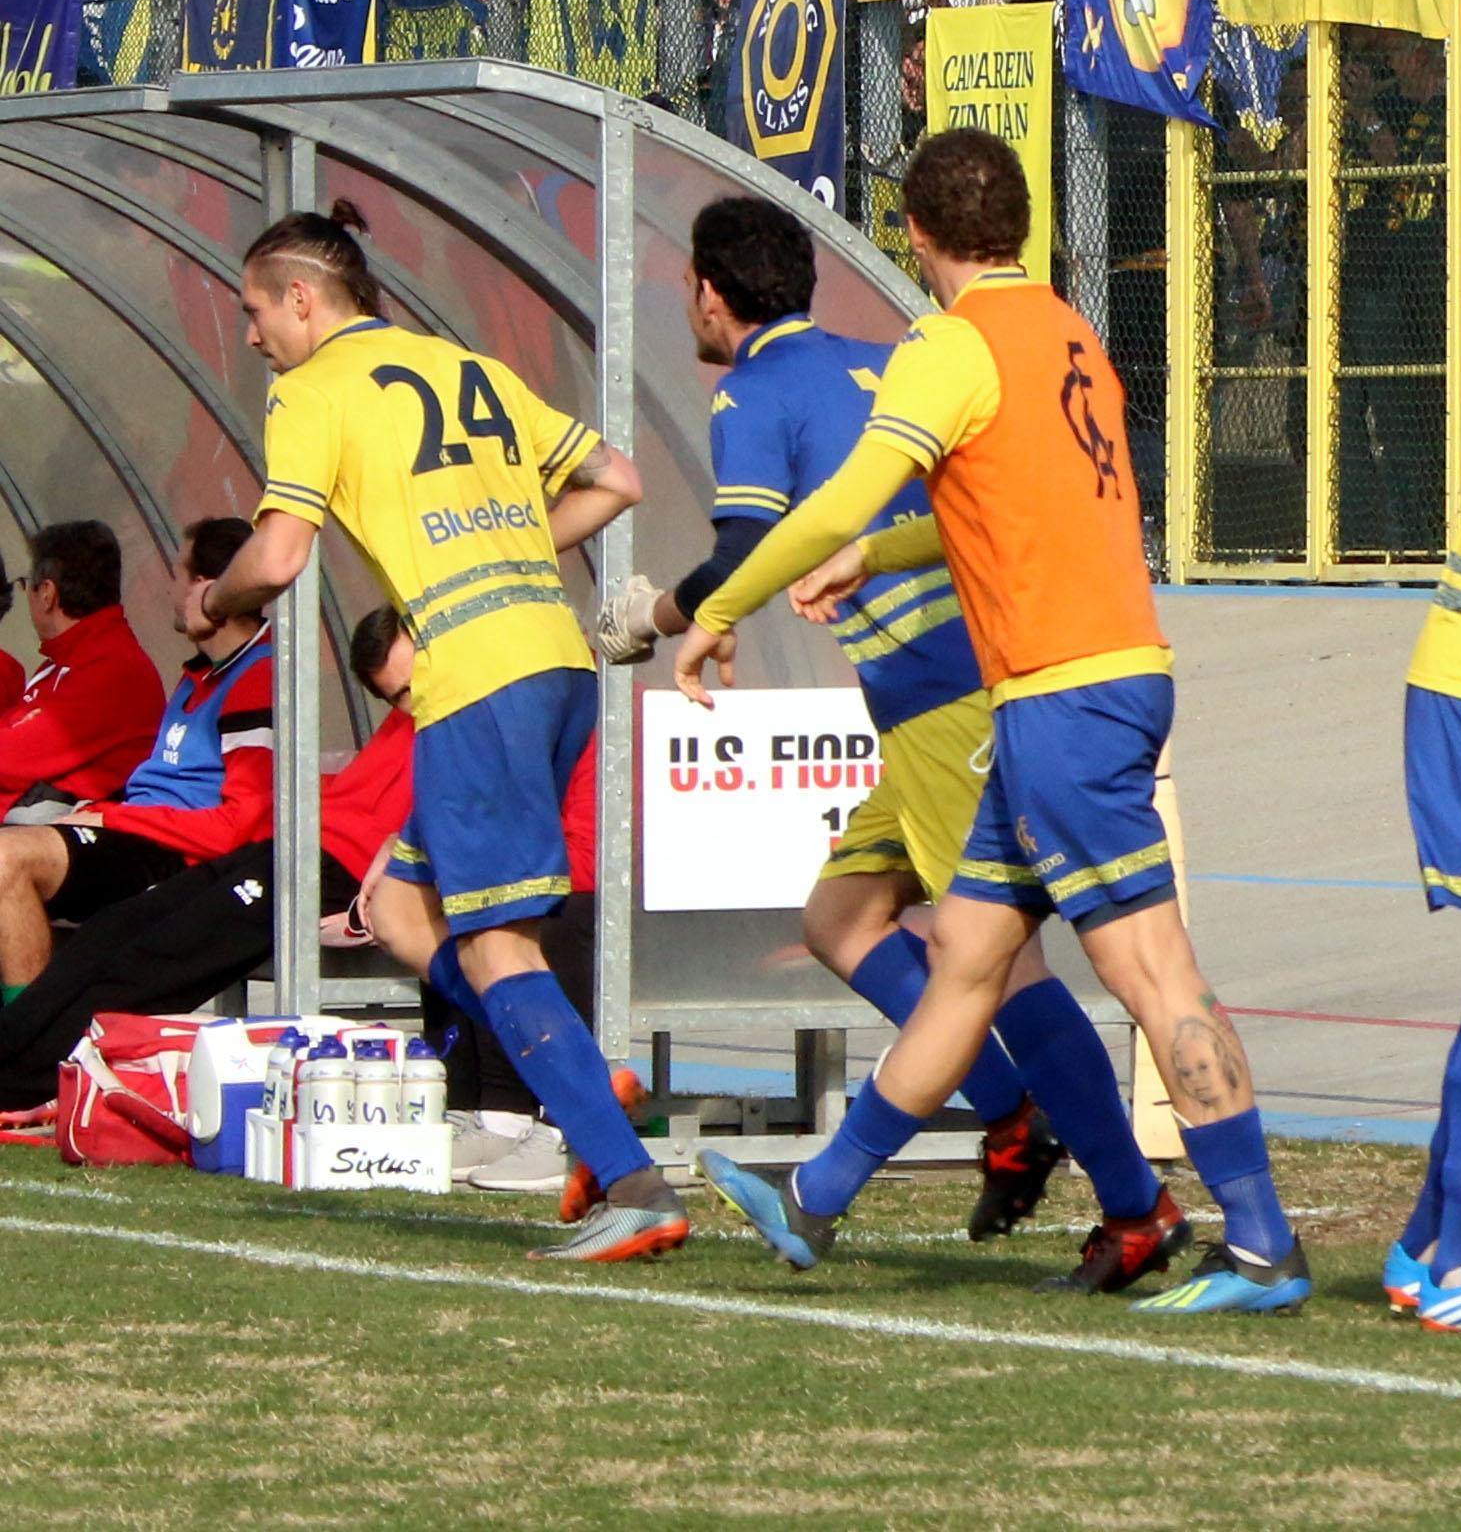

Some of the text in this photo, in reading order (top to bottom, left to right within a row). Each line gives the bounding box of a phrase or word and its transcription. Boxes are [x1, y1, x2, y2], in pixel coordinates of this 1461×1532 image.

[943, 51, 1034, 92] CANAREIN
[756, 78, 810, 133] CLASS
[369, 358, 517, 477] 24
[669, 735, 757, 790] U.S.
[330, 1147, 421, 1179] Sixtus
